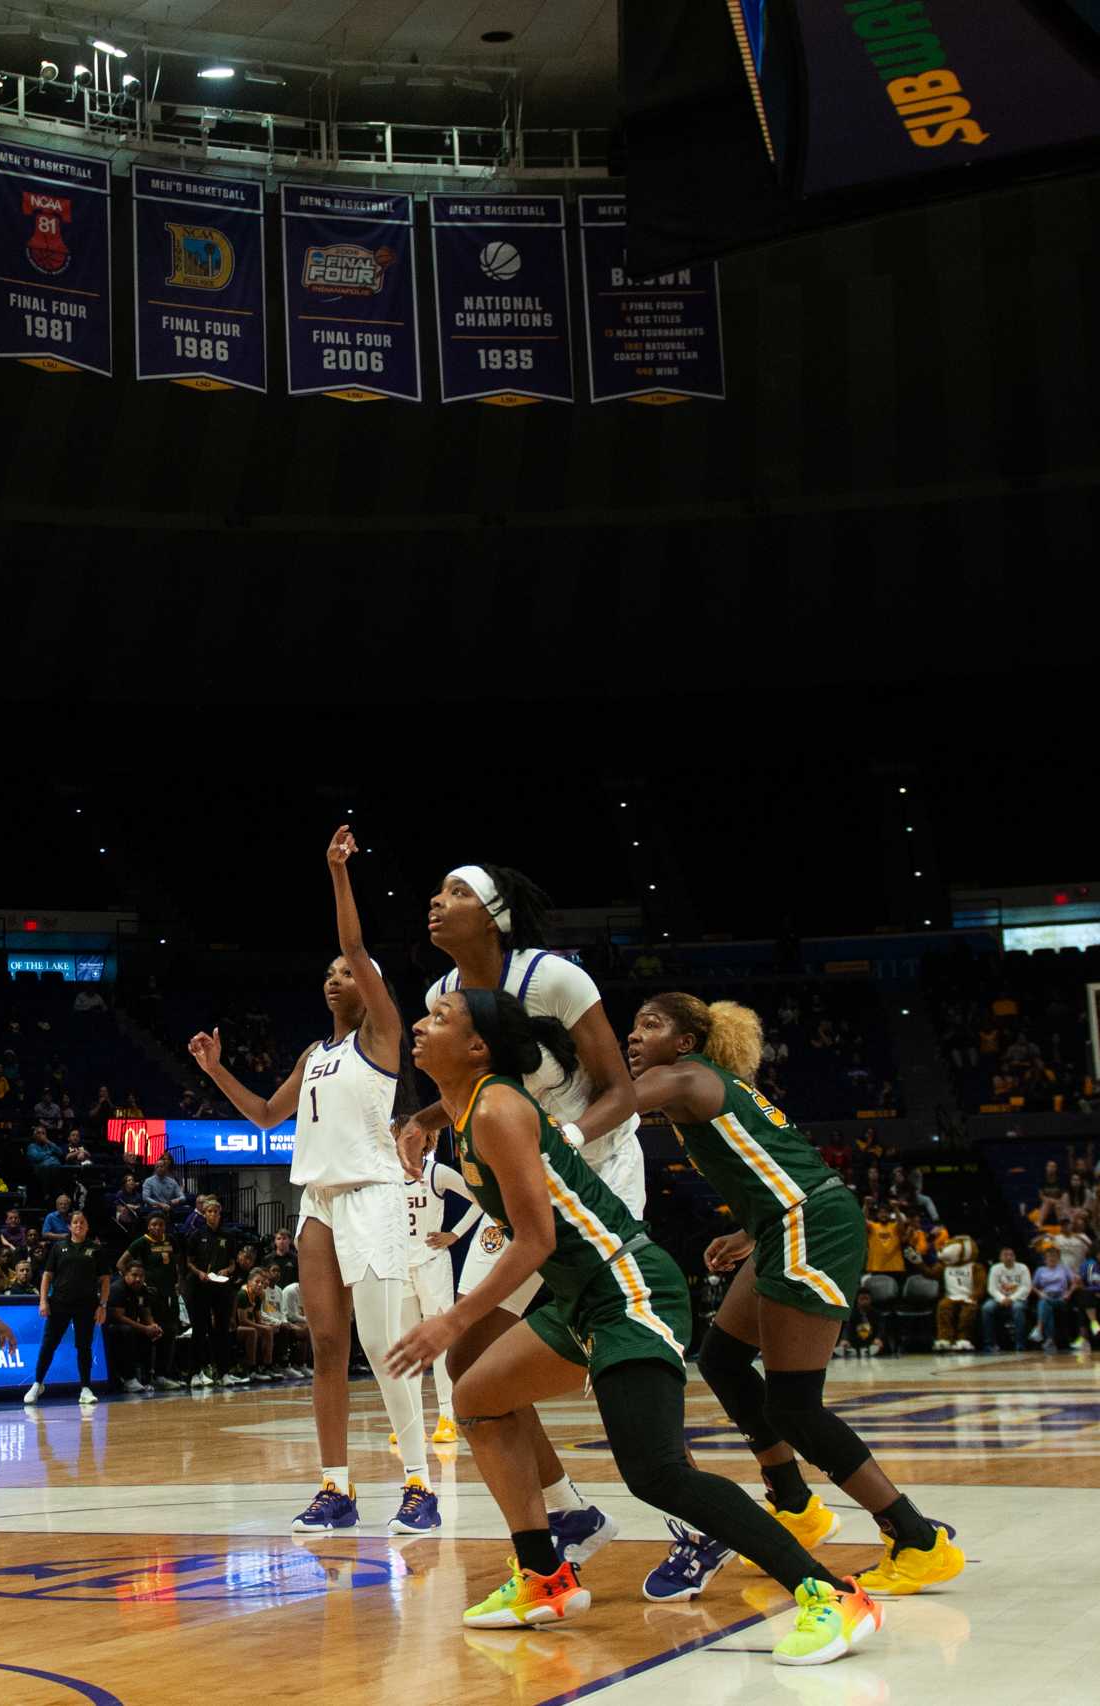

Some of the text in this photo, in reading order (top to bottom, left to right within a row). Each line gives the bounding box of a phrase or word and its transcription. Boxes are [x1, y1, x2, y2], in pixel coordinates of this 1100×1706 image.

[33, 157, 93, 180] BASKETBALL
[149, 178, 246, 201] MEN'S BASKETBALL
[29, 194, 63, 212] NCAA
[299, 194, 396, 214] MEN'S BASKETBALL
[448, 204, 546, 217] MEN'S BASKETBALL
[37, 216, 57, 236] 81
[325, 254, 374, 270] FINAL
[307, 265, 375, 285] FOUR
[610, 266, 692, 287] BWN
[8, 292, 88, 320] FINAL FOUR
[462, 295, 543, 312] NATIONAL
[24, 314, 73, 344] 1981
[161, 315, 242, 338] FINAL FOUR
[454, 312, 554, 328] CHAMPIONS
[173, 335, 230, 363] 1986
[311, 329, 393, 349] FINAL FOUR
[322, 347, 385, 373] 2006
[476, 348, 534, 371] 1935
[23, 961, 44, 971] THE
[46, 961, 70, 971] LAKE
[305, 1059, 341, 1081] SU
[309, 1086, 319, 1123] 1
[214, 1134, 259, 1152] LSU
[408, 1196, 427, 1208] SU
